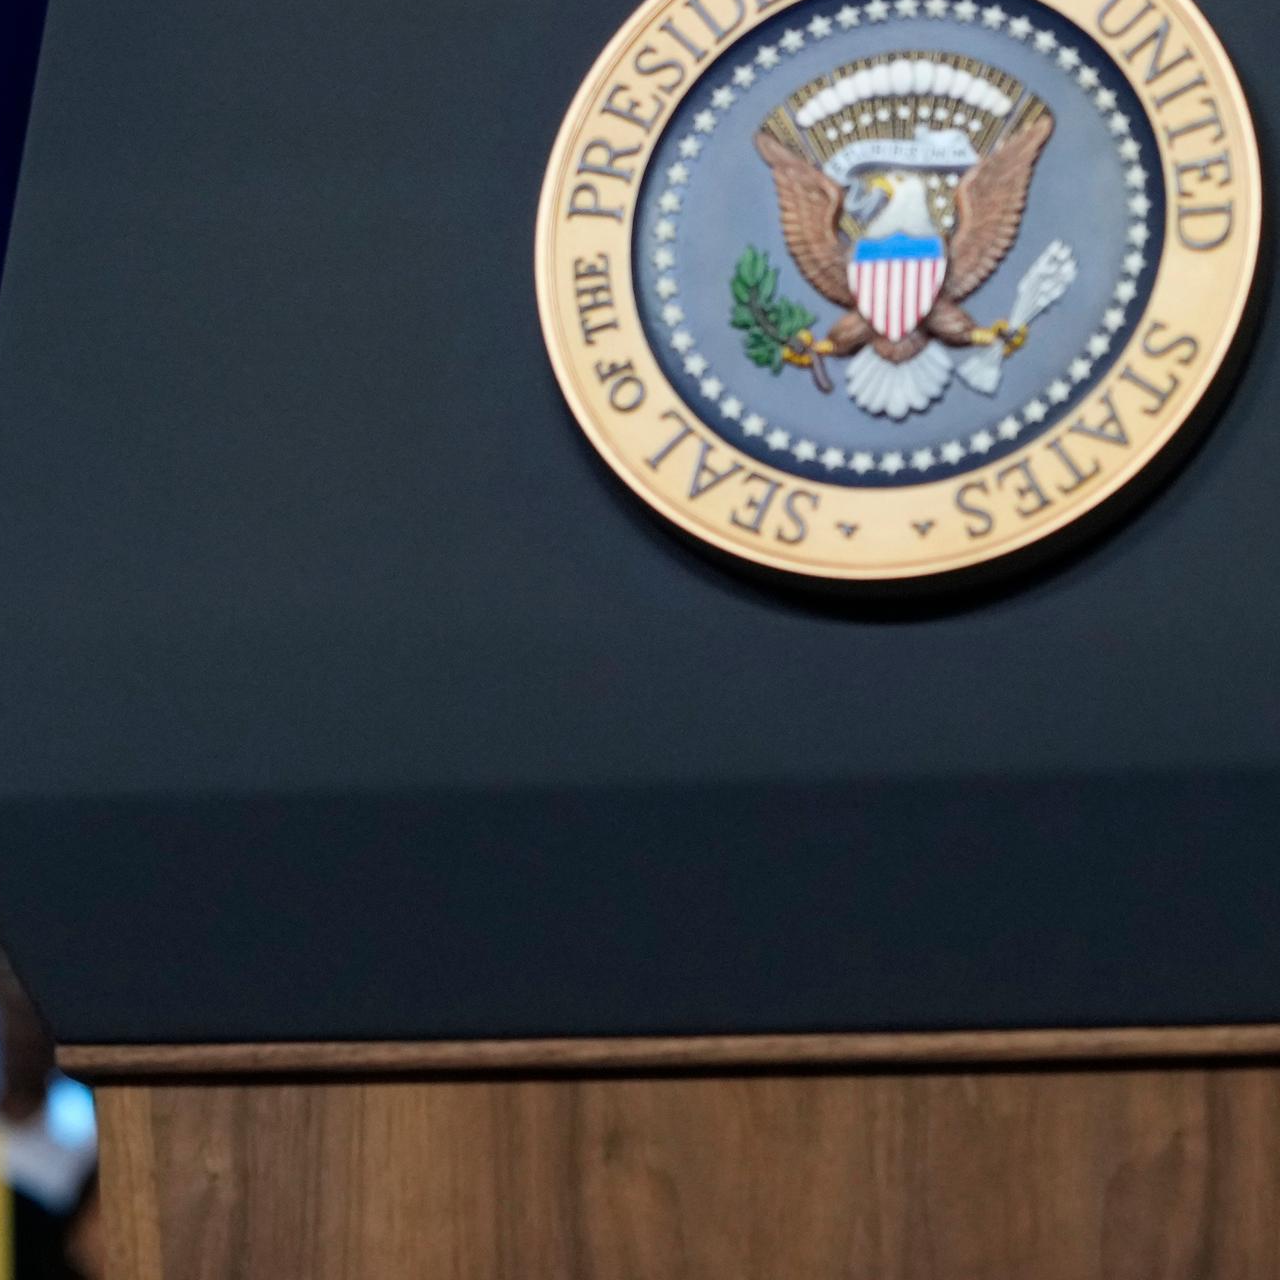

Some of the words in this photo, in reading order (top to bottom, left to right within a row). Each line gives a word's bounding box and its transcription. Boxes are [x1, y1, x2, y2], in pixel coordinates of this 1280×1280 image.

[573, 251, 620, 347] THE
[594, 352, 646, 413] OF
[955, 322, 1199, 538] STATES
[644, 409, 820, 545] SEAL
